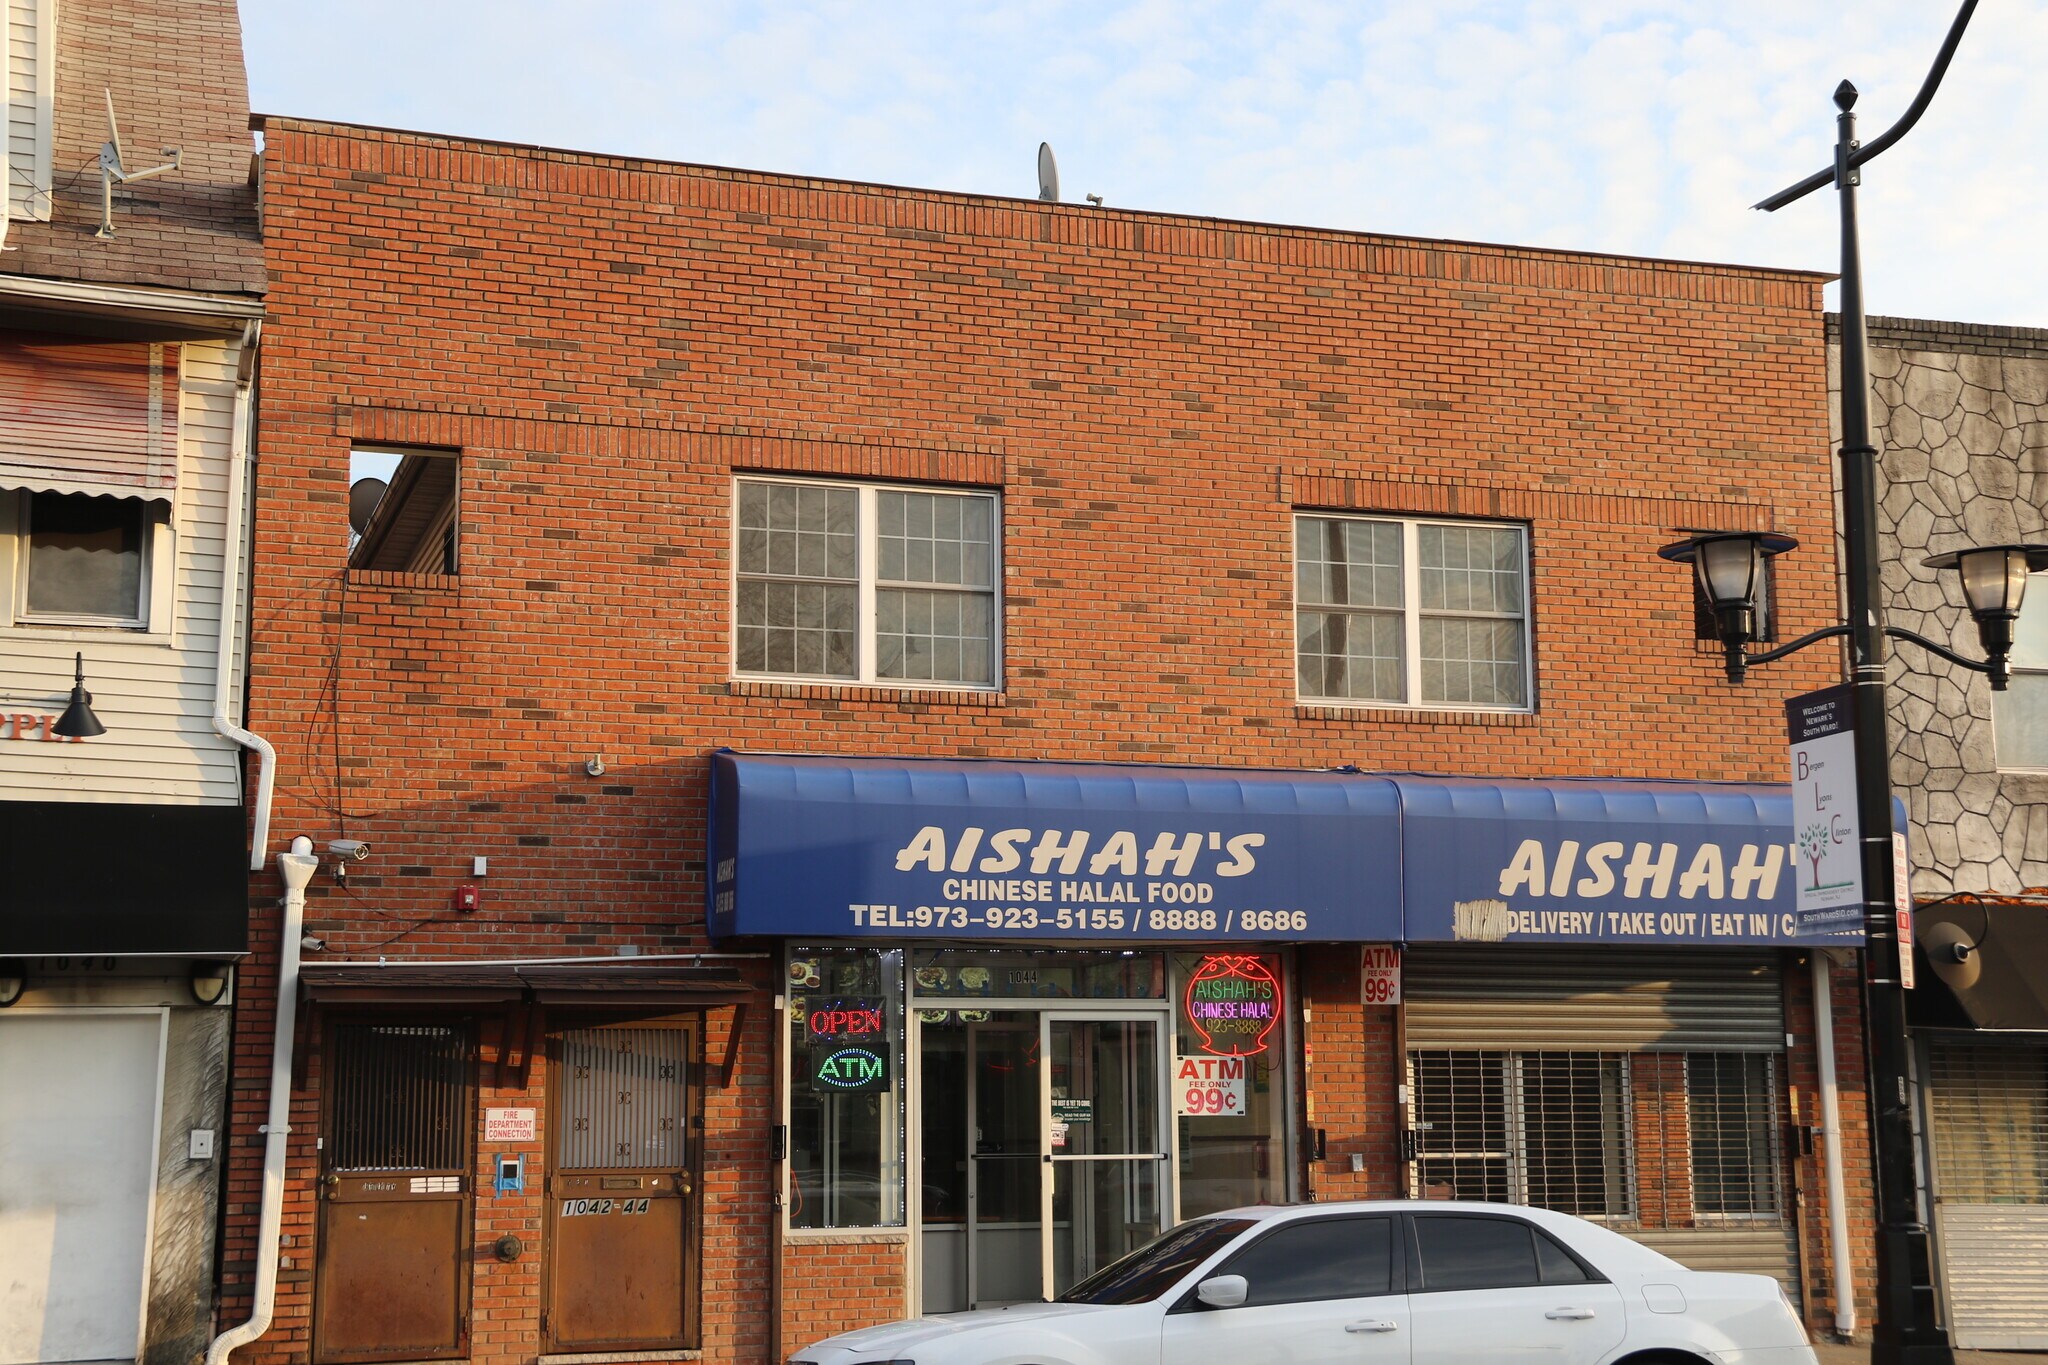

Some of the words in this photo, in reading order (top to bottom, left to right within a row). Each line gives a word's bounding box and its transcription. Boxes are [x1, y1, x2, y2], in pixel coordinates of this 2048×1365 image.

[1802, 704, 1828, 716] WELCOME
[1828, 702, 1836, 710] TO
[1806, 713, 1833, 726] NEWARK'S
[1803, 727, 1820, 737] SOUTH
[1797, 751, 1825, 781] Bergen
[1831, 814, 1851, 844] Clinton
[895, 826, 1267, 878] AISHAH'S
[1498, 839, 1797, 900] AISHAH'
[943, 879, 1052, 902] CHINESE
[1061, 881, 1140, 903] HALAL
[1148, 882, 1214, 904] FOOD
[849, 905, 1125, 930] TEL:973-923-5155
[1149, 909, 1217, 930] 8888
[1240, 910, 1307, 931] 8686
[1507, 911, 1594, 934] DELIVERY
[1608, 912, 1656, 935] TAKE
[1660, 912, 1696, 935] OUT
[1711, 913, 1745, 936] EAT
[1749, 914, 1768, 936] IN
[1362, 948, 1399, 968] ATM
[1008, 971, 1038, 984] 1044
[1195, 980, 1272, 999] AISHAH'S
[1365, 978, 1395, 1003] 99¢
[1192, 1001, 1238, 1018] CHINESE
[1240, 1001, 1273, 1019] HALAL
[810, 1010, 882, 1034] OPEN
[1205, 1018, 1262, 1033] 923-8888
[817, 1057, 883, 1078] ATM
[1178, 1059, 1243, 1080] ATM
[1185, 1088, 1237, 1114] 99¢
[488, 1120, 532, 1129] DEPARTMENT
[503, 1110, 518, 1120] FIRE
[488, 1129, 532, 1139] CONNECTION
